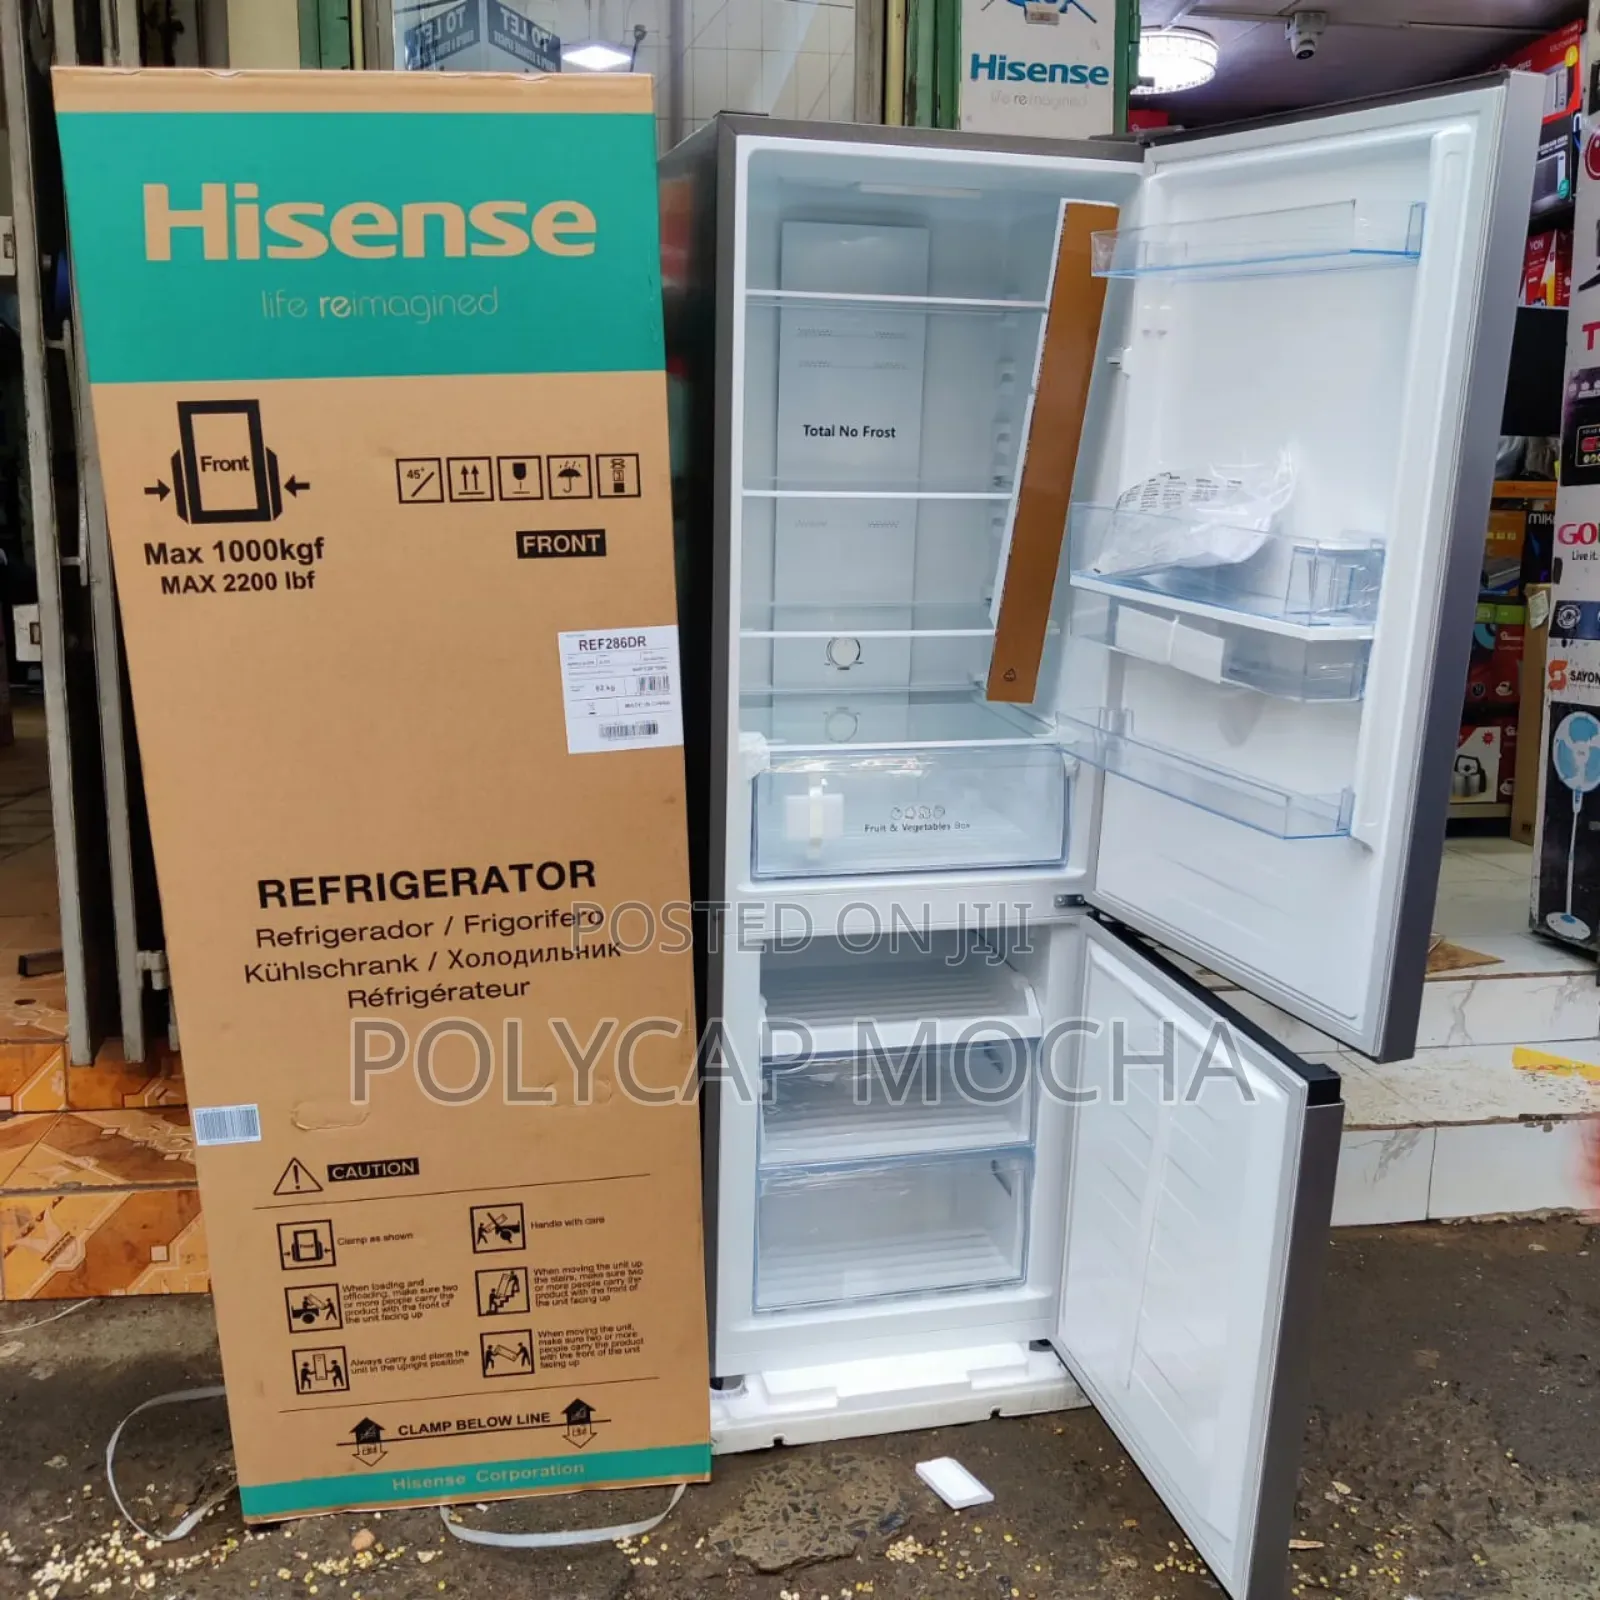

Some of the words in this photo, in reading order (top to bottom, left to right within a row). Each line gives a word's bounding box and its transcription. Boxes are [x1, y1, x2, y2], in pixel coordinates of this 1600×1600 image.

[970, 53, 1109, 85] Hisense
[143, 182, 597, 261] Hisense
[261, 288, 308, 319] life
[319, 285, 499, 324] reimagined
[802, 424, 835, 437] Total
[839, 425, 858, 437] No
[863, 425, 896, 438] Frost
[200, 455, 250, 473] Front
[522, 533, 601, 555] FRONT
[1557, 522, 1600, 545] GO
[144, 541, 204, 566] Max
[212, 537, 325, 564] 1000kgf
[1572, 550, 1588, 561] Live
[160, 574, 215, 595] MAX
[222, 572, 277, 592] 2200
[285, 569, 316, 590] lbf
[579, 635, 647, 651] REF286DR
[864, 823, 887, 833] Fruit
[890, 824, 899, 833] &
[901, 821, 951, 833] Vegetables
[257, 859, 597, 909] REFRIGERATOR
[256, 916, 434, 950] Refrigerador
[443, 916, 454, 936] /
[464, 907, 604, 937] Frigorifero
[244, 954, 419, 984] Kühlschrank
[428, 951, 437, 971] /
[448, 942, 622, 970] Холодильник
[347, 978, 531, 1010] Réfrigérateur
[331, 1160, 415, 1181] CAUTION
[530, 1219, 563, 1229] Handle
[564, 1217, 583, 1227] with
[584, 1216, 605, 1225] care
[337, 1236, 368, 1246] Clamp
[369, 1235, 381, 1243] as
[383, 1232, 414, 1242] shown
[534, 1267, 559, 1276] When
[562, 1264, 595, 1274] moving
[613, 1260, 629, 1269] unit
[631, 1260, 643, 1269] up
[342, 1283, 369, 1293] When
[371, 1281, 405, 1292] loading
[407, 1278, 425, 1288] and
[350, 1358, 382, 1367] Always
[384, 1355, 407, 1364] carry
[409, 1352, 426, 1361] and
[428, 1350, 453, 1360] place
[454, 1349, 470, 1357] the
[397, 1421, 451, 1436] CLAMP
[456, 1415, 513, 1431] BELOW
[516, 1411, 551, 1425] LINE
[392, 1474, 466, 1492] Hisense
[476, 1461, 585, 1484] Corporation
